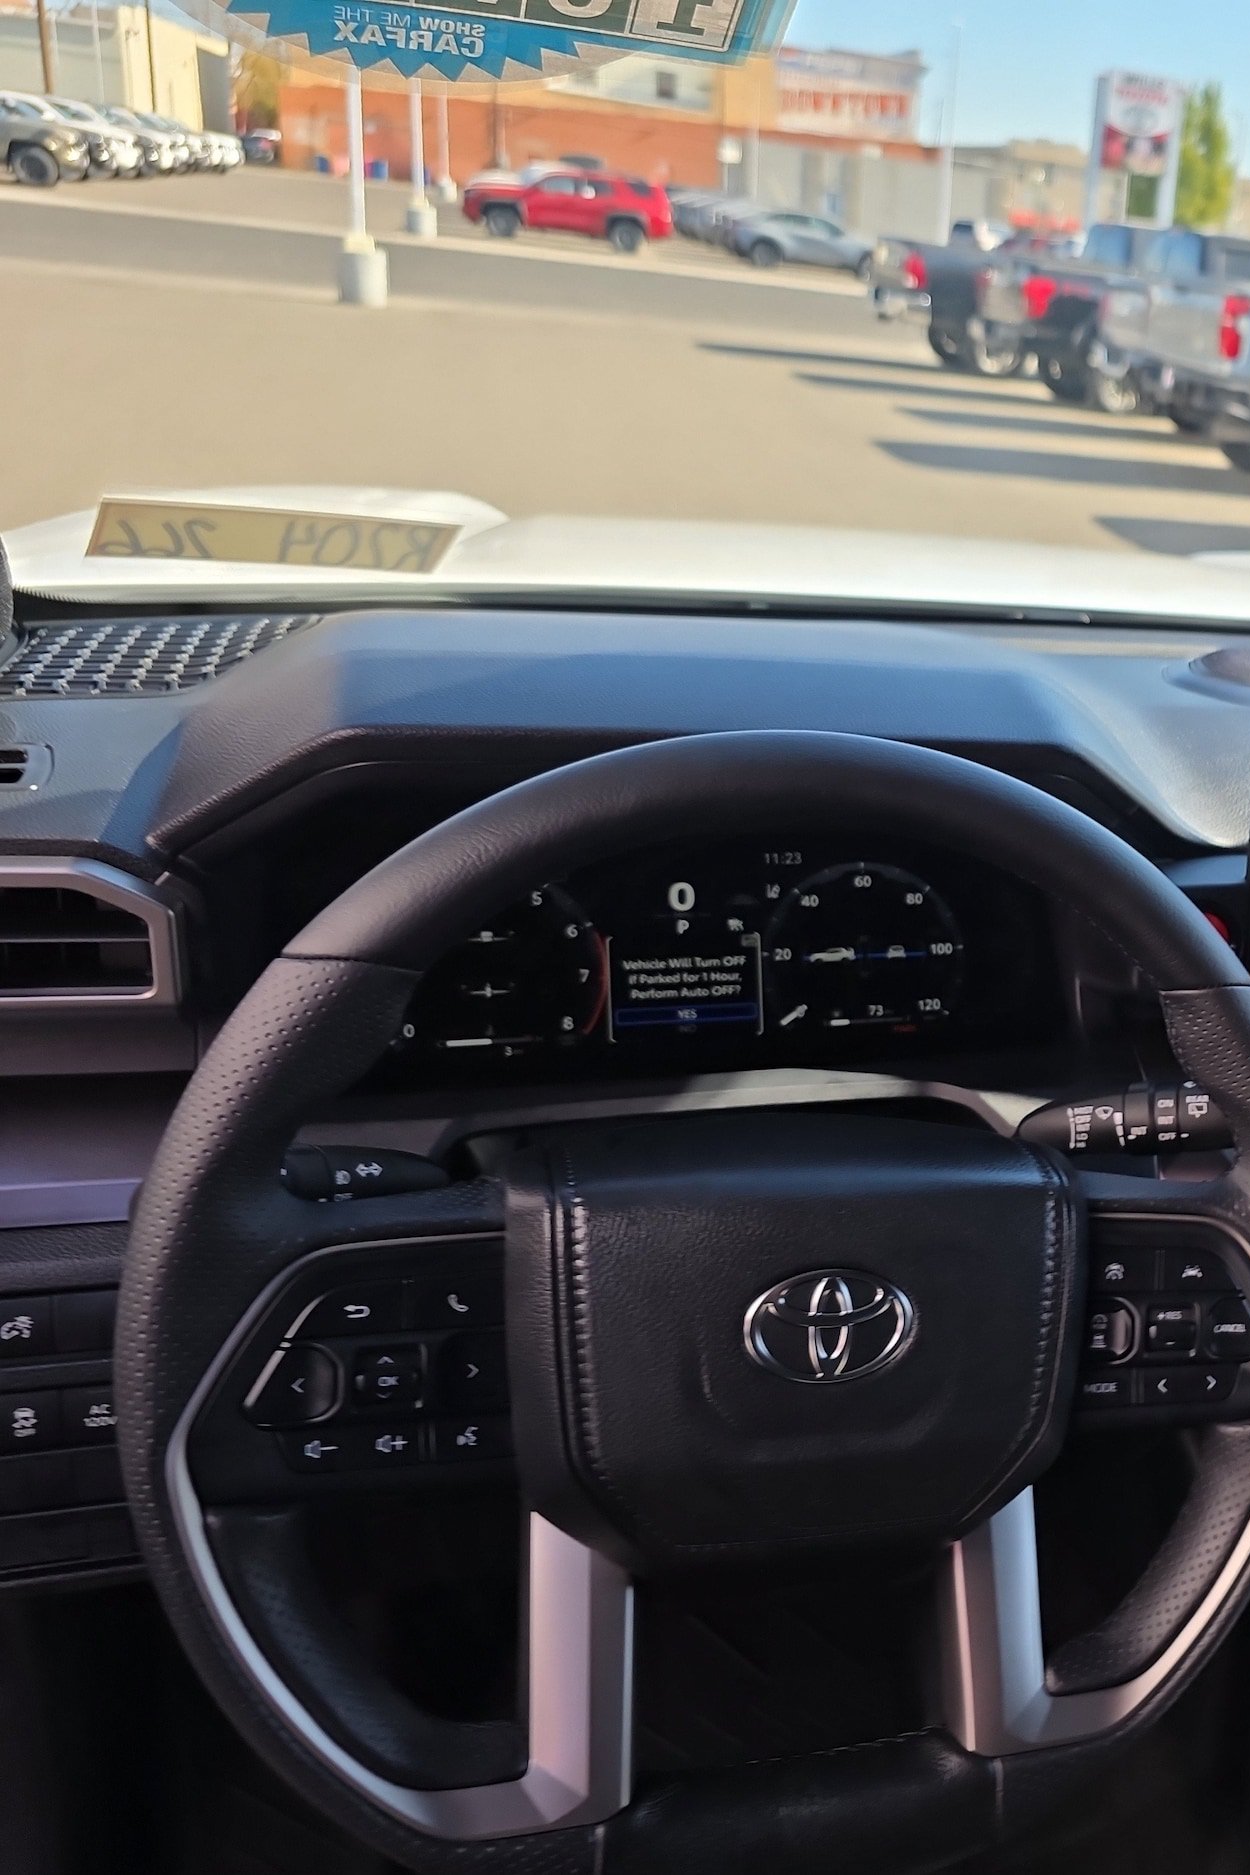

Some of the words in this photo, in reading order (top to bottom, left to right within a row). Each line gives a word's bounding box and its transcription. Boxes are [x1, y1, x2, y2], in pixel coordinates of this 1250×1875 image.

[764, 852, 803, 865] 11:23
[853, 875, 872, 888] 60
[531, 890, 543, 906] 5
[668, 881, 696, 912] 0
[800, 894, 820, 908] 40
[905, 892, 924, 905] 80
[565, 924, 579, 938] 6
[676, 919, 690, 935] P
[774, 948, 792, 961] 20
[930, 942, 954, 955] 100
[622, 959, 667, 970] Vehicle
[668, 957, 692, 968] Will
[693, 956, 720, 968] Turn
[722, 955, 747, 966] OFF
[579, 968, 590, 983] 7
[639, 972, 681, 984] Parked
[682, 971, 700, 982] for
[631, 988, 679, 999] Perform
[680, 986, 710, 997] Auto
[711, 984, 742, 996] OFF?
[868, 1004, 884, 1017] 73
[918, 998, 941, 1011] 120
[677, 1008, 698, 1019] YES
[562, 1016, 574, 1031] 8
[402, 1023, 415, 1038] 0
[1084, 1381, 1118, 1394] MODE
